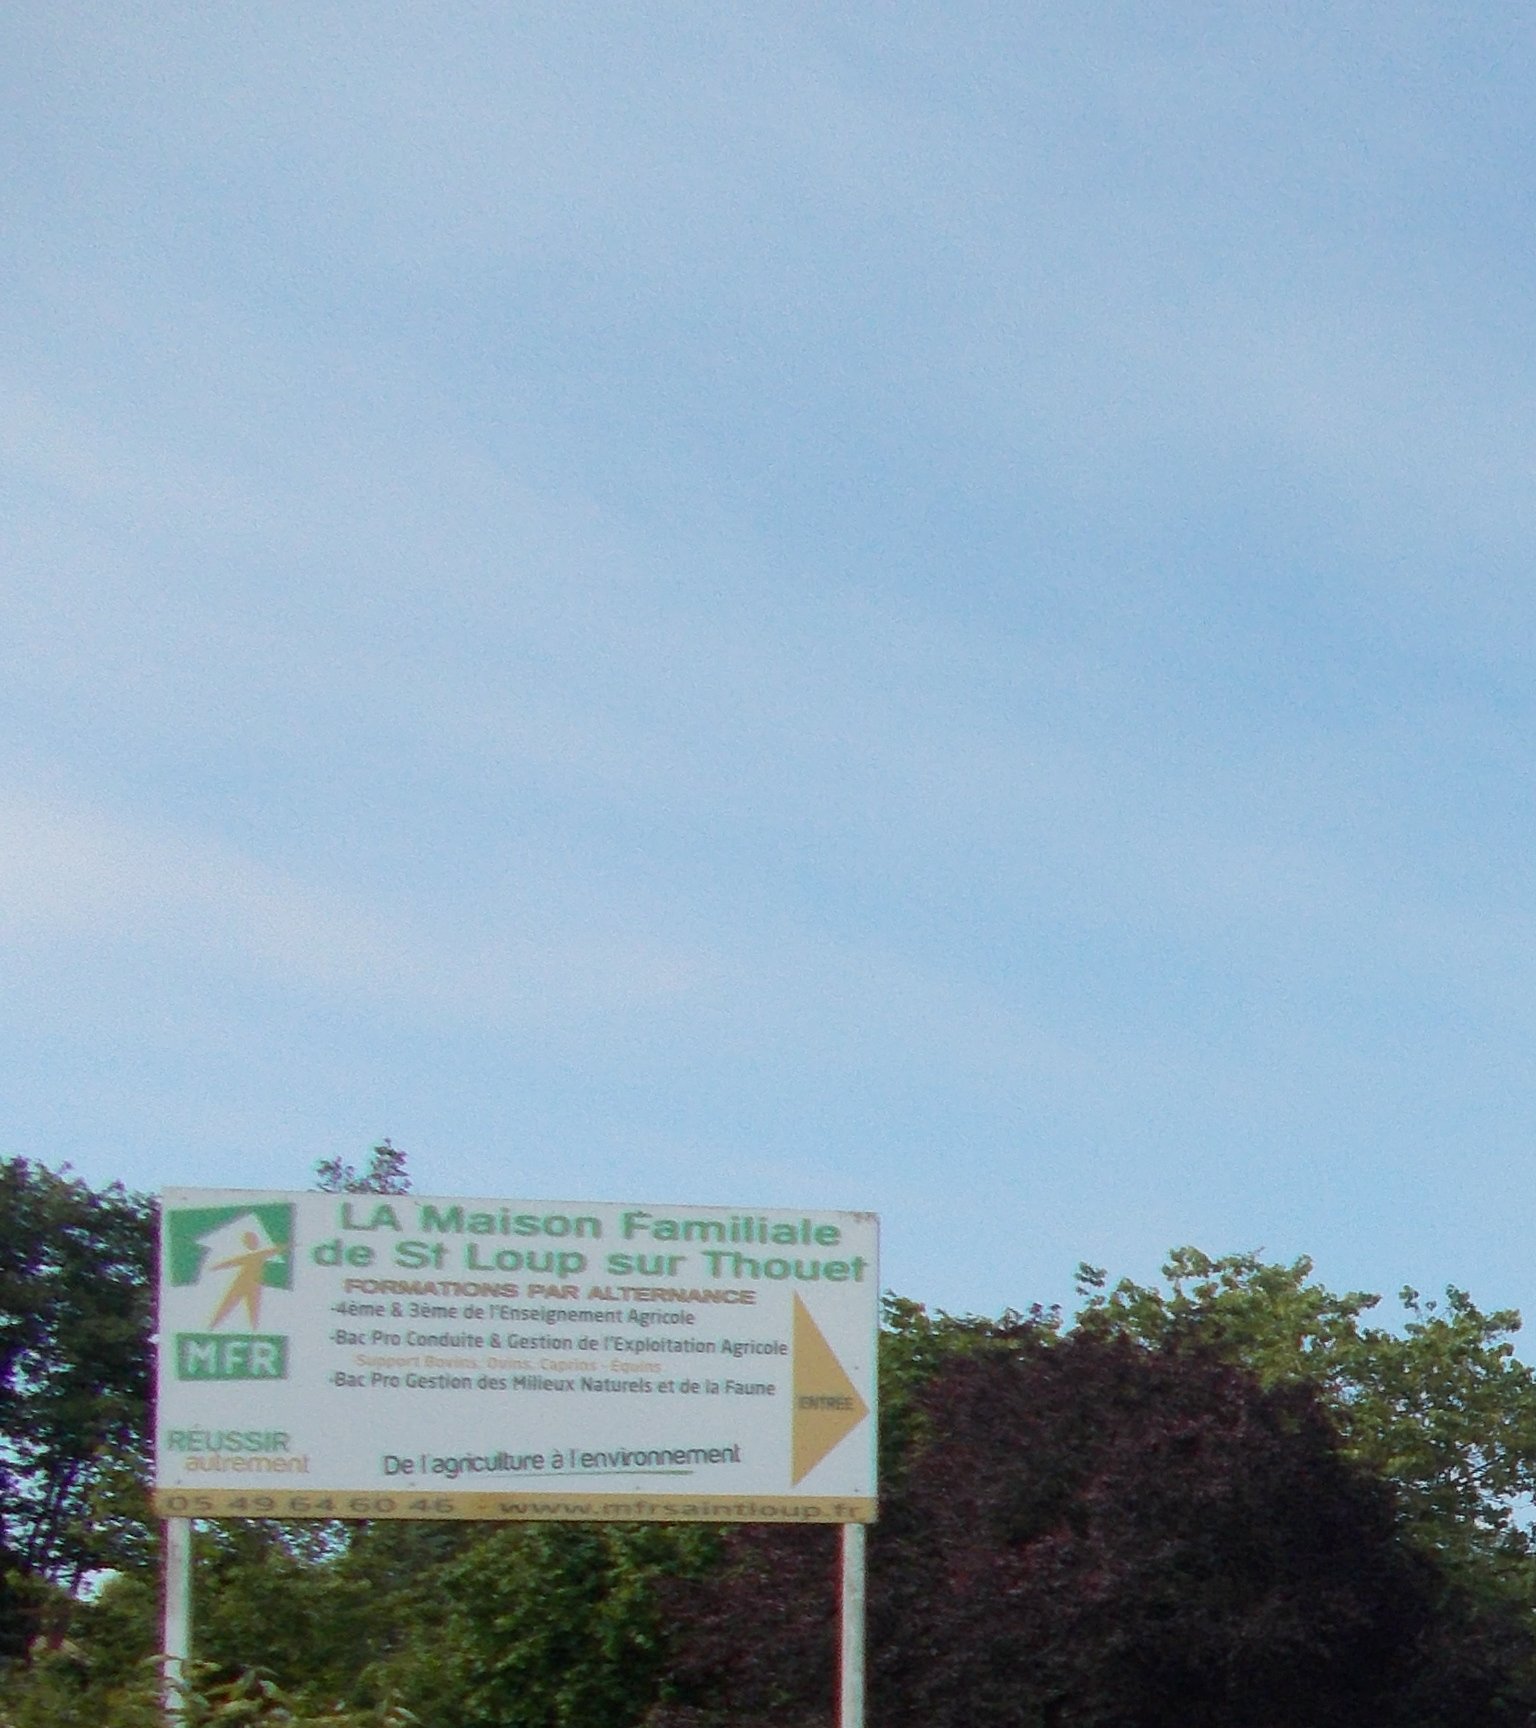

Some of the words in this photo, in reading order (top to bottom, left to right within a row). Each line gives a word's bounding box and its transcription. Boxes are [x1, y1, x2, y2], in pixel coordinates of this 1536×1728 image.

[340, 1202, 402, 1232] LA
[419, 1203, 602, 1239] Maison
[622, 1210, 841, 1246] Familiale
[312, 1238, 375, 1267] de
[395, 1241, 449, 1270] St
[466, 1242, 588, 1278] Loup
[607, 1252, 686, 1276] sur
[702, 1250, 868, 1282] Thouet
[344, 1278, 519, 1298] FORMATIONS
[527, 1284, 579, 1300] PAR
[587, 1287, 756, 1304] ALTERNANCE
[391, 1302, 404, 1317] &
[409, 1303, 458, 1319] 3ème
[463, 1304, 482, 1320] de
[490, 1304, 622, 1324] l'Enseignement
[628, 1310, 695, 1328] Agricole
[184, 1339, 279, 1375] MFR
[371, 1331, 400, 1346] Pro
[407, 1331, 483, 1348] Conduite
[490, 1334, 503, 1348] &
[507, 1334, 572, 1351] Gestion
[578, 1336, 599, 1351] de
[604, 1336, 715, 1356] l'Exploitation
[722, 1340, 789, 1358] Agricole
[356, 1354, 420, 1370] Support
[540, 1358, 597, 1374] Caprins
[371, 1372, 400, 1388] Pro
[406, 1373, 472, 1390] Gestion
[478, 1374, 506, 1390] des
[513, 1375, 574, 1392] Milieux
[581, 1377, 651, 1394] Naturels
[657, 1379, 674, 1394] et
[680, 1379, 699, 1395] de
[705, 1379, 719, 1395] la
[725, 1381, 776, 1396] Faune
[166, 1424, 290, 1451] RÉUSSIR
[184, 1452, 309, 1474] autrement
[384, 1455, 413, 1476] De
[551, 1452, 564, 1471] à
[167, 1496, 212, 1512] 05
[228, 1496, 275, 1512] 49
[288, 1497, 335, 1513] 64
[349, 1497, 397, 1514] 60
[499, 1500, 860, 1520] www.mfrsaintloup.fr
